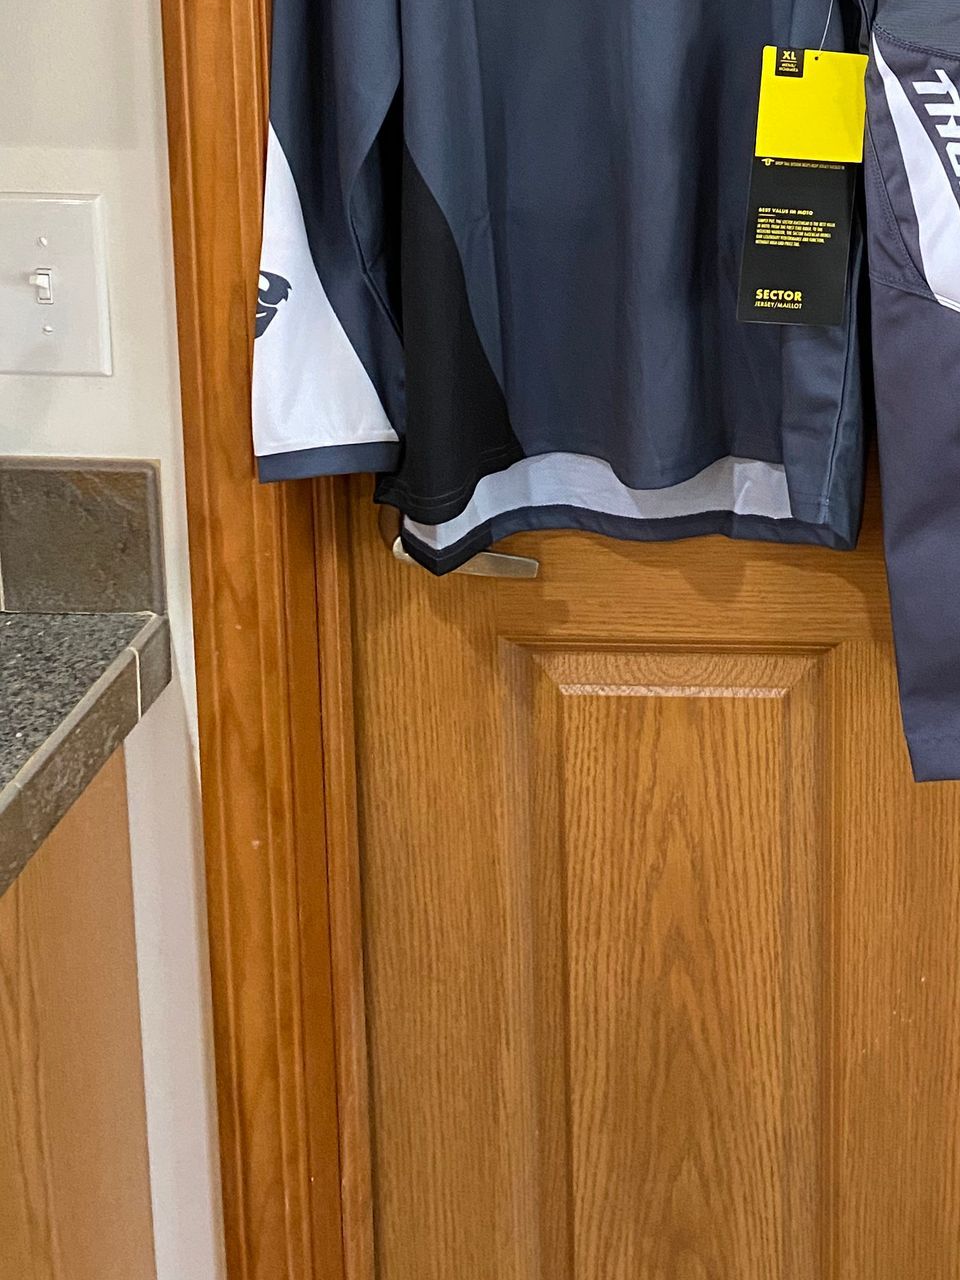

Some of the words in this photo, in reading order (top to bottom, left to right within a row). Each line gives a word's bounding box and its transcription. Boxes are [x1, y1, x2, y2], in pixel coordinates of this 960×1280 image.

[782, 50, 797, 61] XL
[755, 288, 803, 302] SECTOR
[754, 301, 803, 310] JERSEY/MAILLOT
